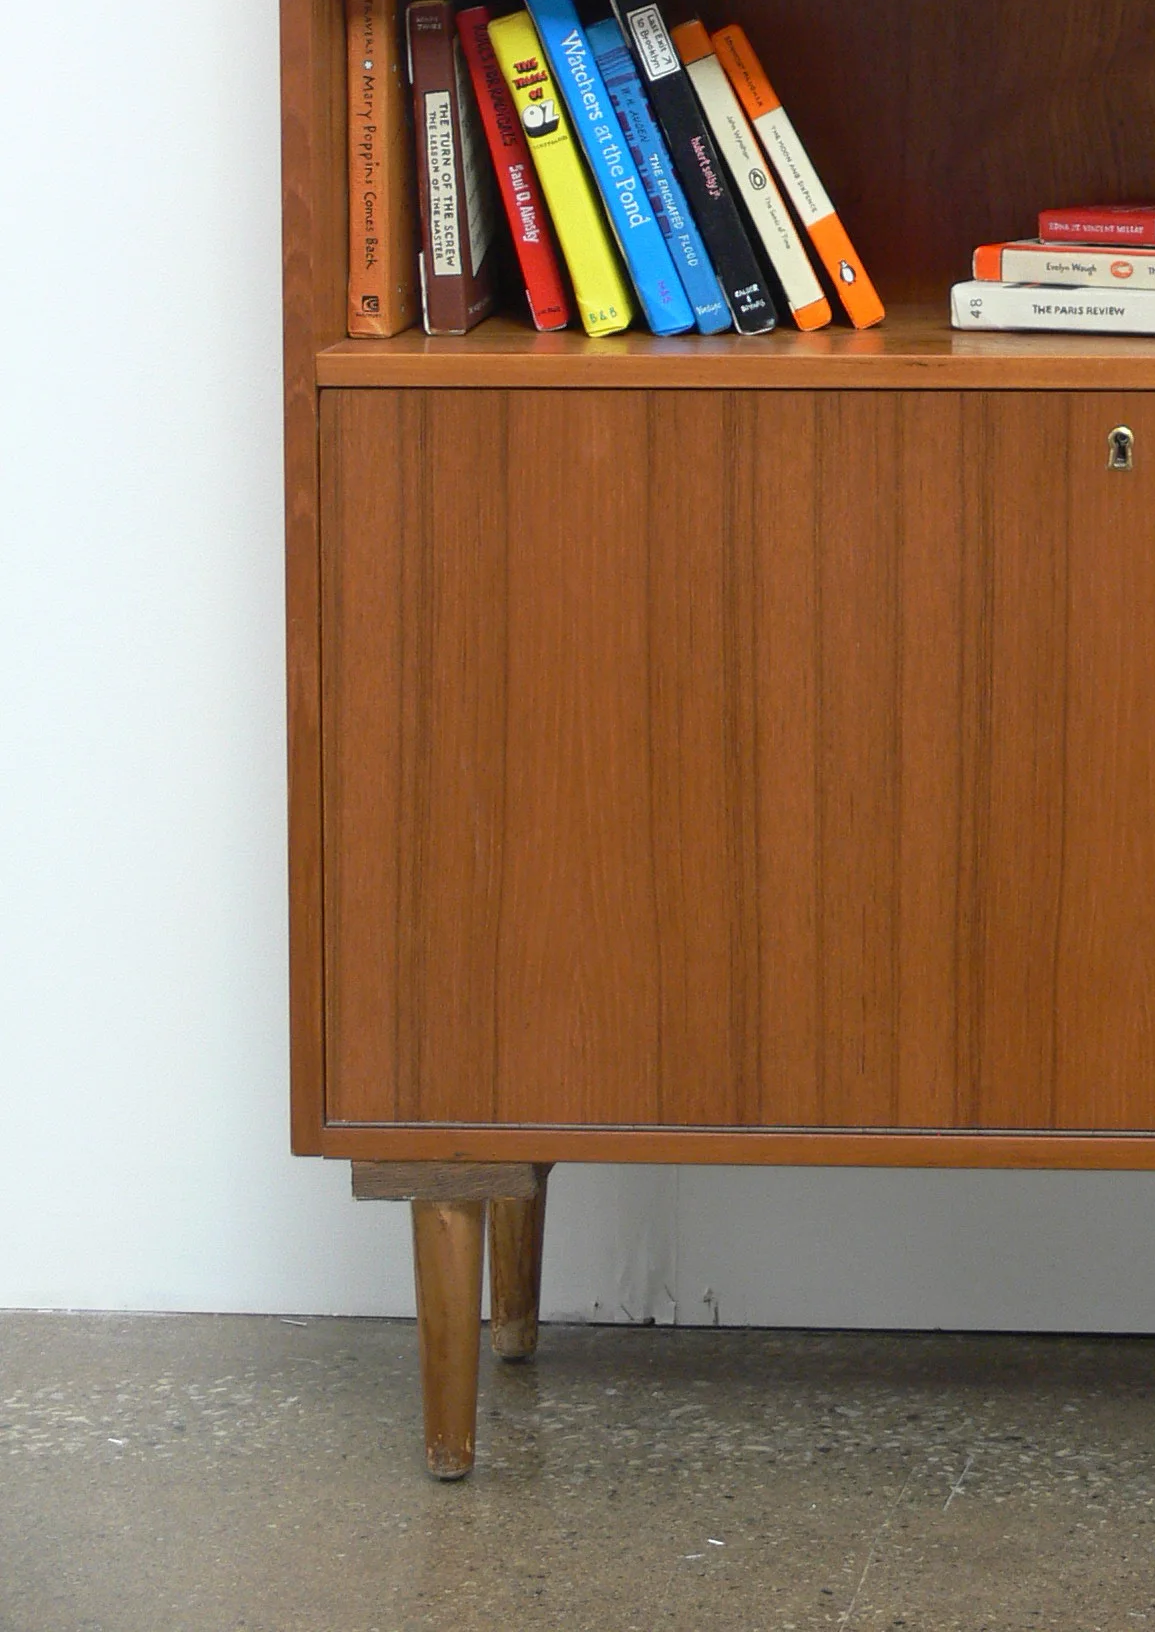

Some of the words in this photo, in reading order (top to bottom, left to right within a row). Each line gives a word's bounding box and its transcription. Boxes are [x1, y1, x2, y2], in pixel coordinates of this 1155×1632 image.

[513, 56, 539, 73] THE
[560, 28, 605, 122] Watchers
[356, 74, 377, 120] Mary
[438, 102, 451, 125] THE
[429, 111, 438, 131] THE
[521, 99, 561, 139] OZ
[593, 123, 614, 144] at
[358, 124, 380, 186] Poppins
[430, 136, 440, 174] LESSON
[439, 131, 453, 167] TURN
[602, 142, 626, 178] the
[431, 178, 441, 192] OF
[441, 171, 453, 189] OF
[508, 163, 530, 191] Saul
[362, 190, 378, 233] Comes
[432, 196, 441, 215] THE
[443, 195, 455, 219] THE
[515, 190, 532, 207] D.
[615, 175, 652, 230] Pond
[648, 153, 664, 177] THE
[678, 233, 700, 268] FLOOD
[432, 217, 444, 260] MASTER
[519, 203, 541, 244] Alinsky
[364, 236, 379, 270] Back
[443, 224, 457, 268] SCREW
[1032, 304, 1053, 315] THE
[1054, 305, 1084, 316] PARIS
[1085, 305, 1126, 317] REVIEW
